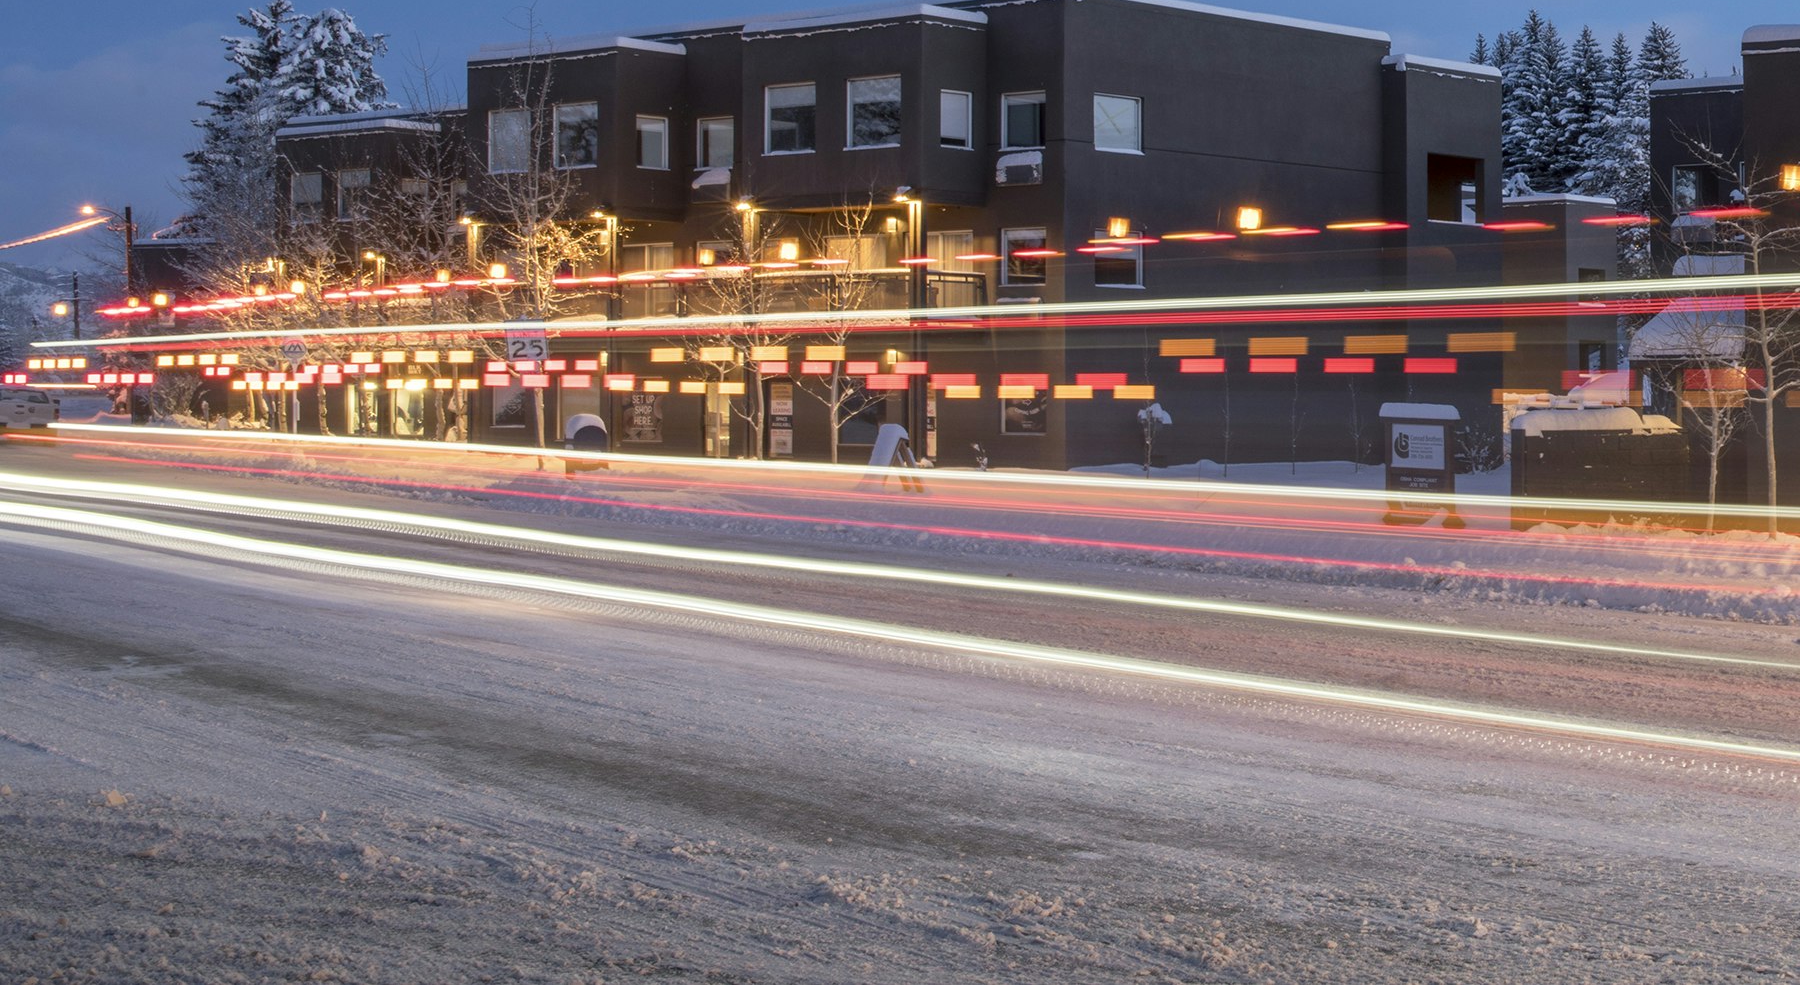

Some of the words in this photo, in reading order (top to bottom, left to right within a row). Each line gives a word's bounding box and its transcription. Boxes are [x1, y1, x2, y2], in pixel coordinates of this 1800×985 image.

[512, 340, 544, 358] 25
[632, 395, 644, 404] SET
[645, 395, 655, 404] UP
[634, 406, 652, 414] SHOP
